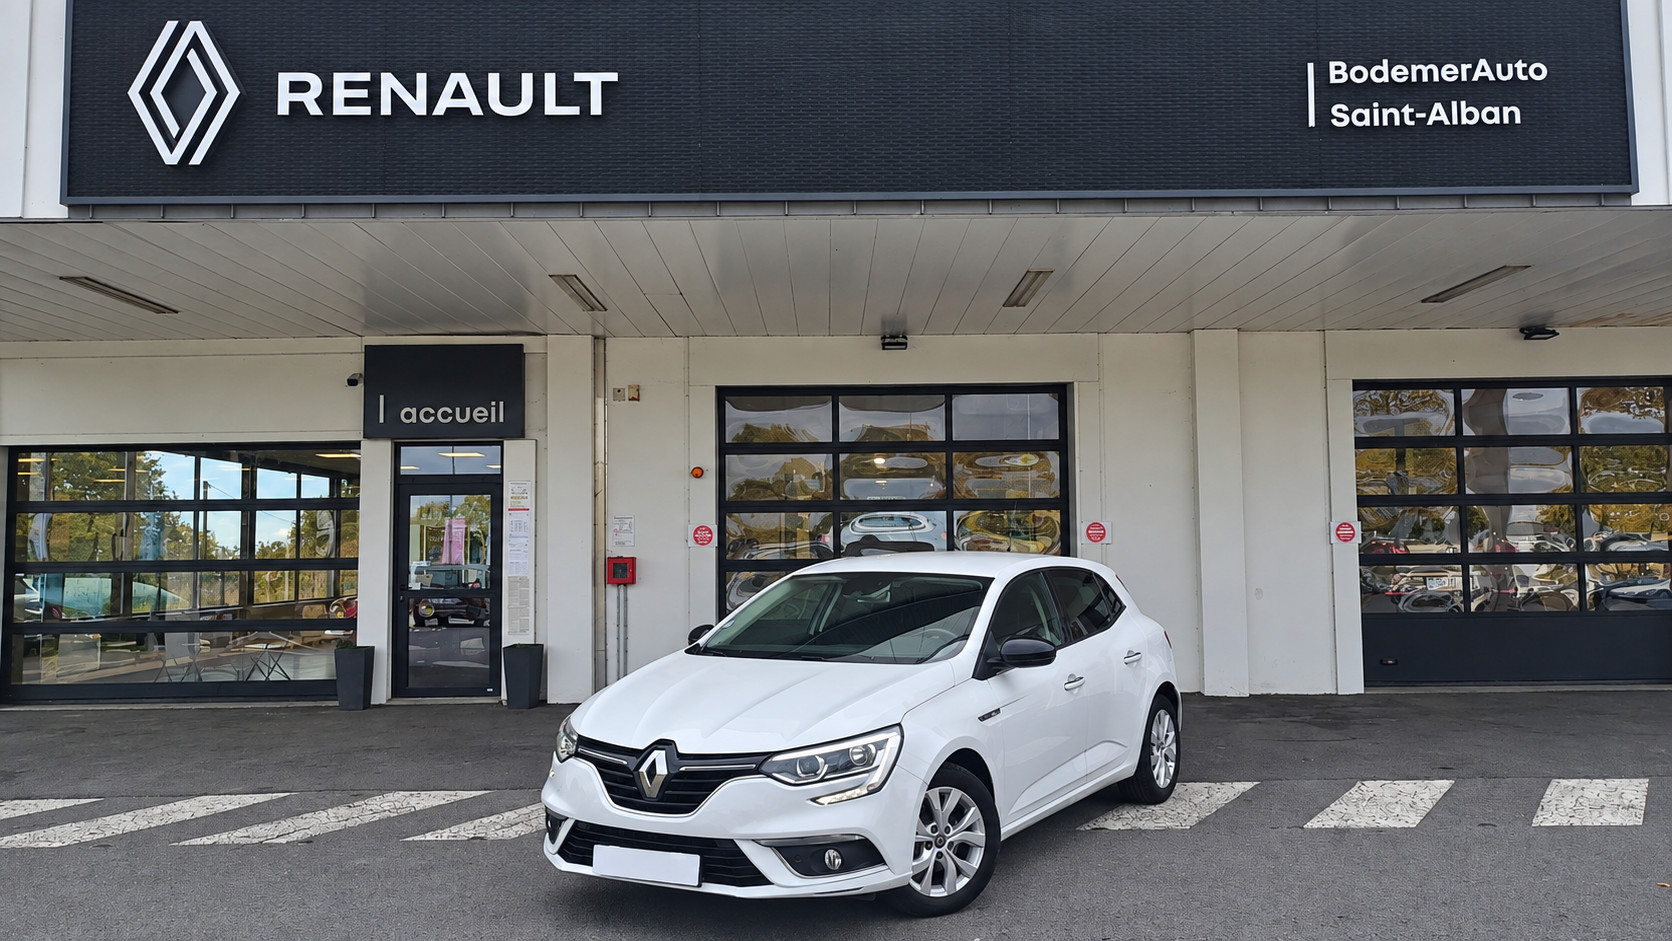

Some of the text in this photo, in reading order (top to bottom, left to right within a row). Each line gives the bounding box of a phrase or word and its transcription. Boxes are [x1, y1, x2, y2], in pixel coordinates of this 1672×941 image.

[1328, 58, 1548, 84] BodemerAuto
[277, 72, 619, 117] RENAULT
[1330, 100, 1521, 127] Saint-Alban
[399, 401, 505, 424] accueil
